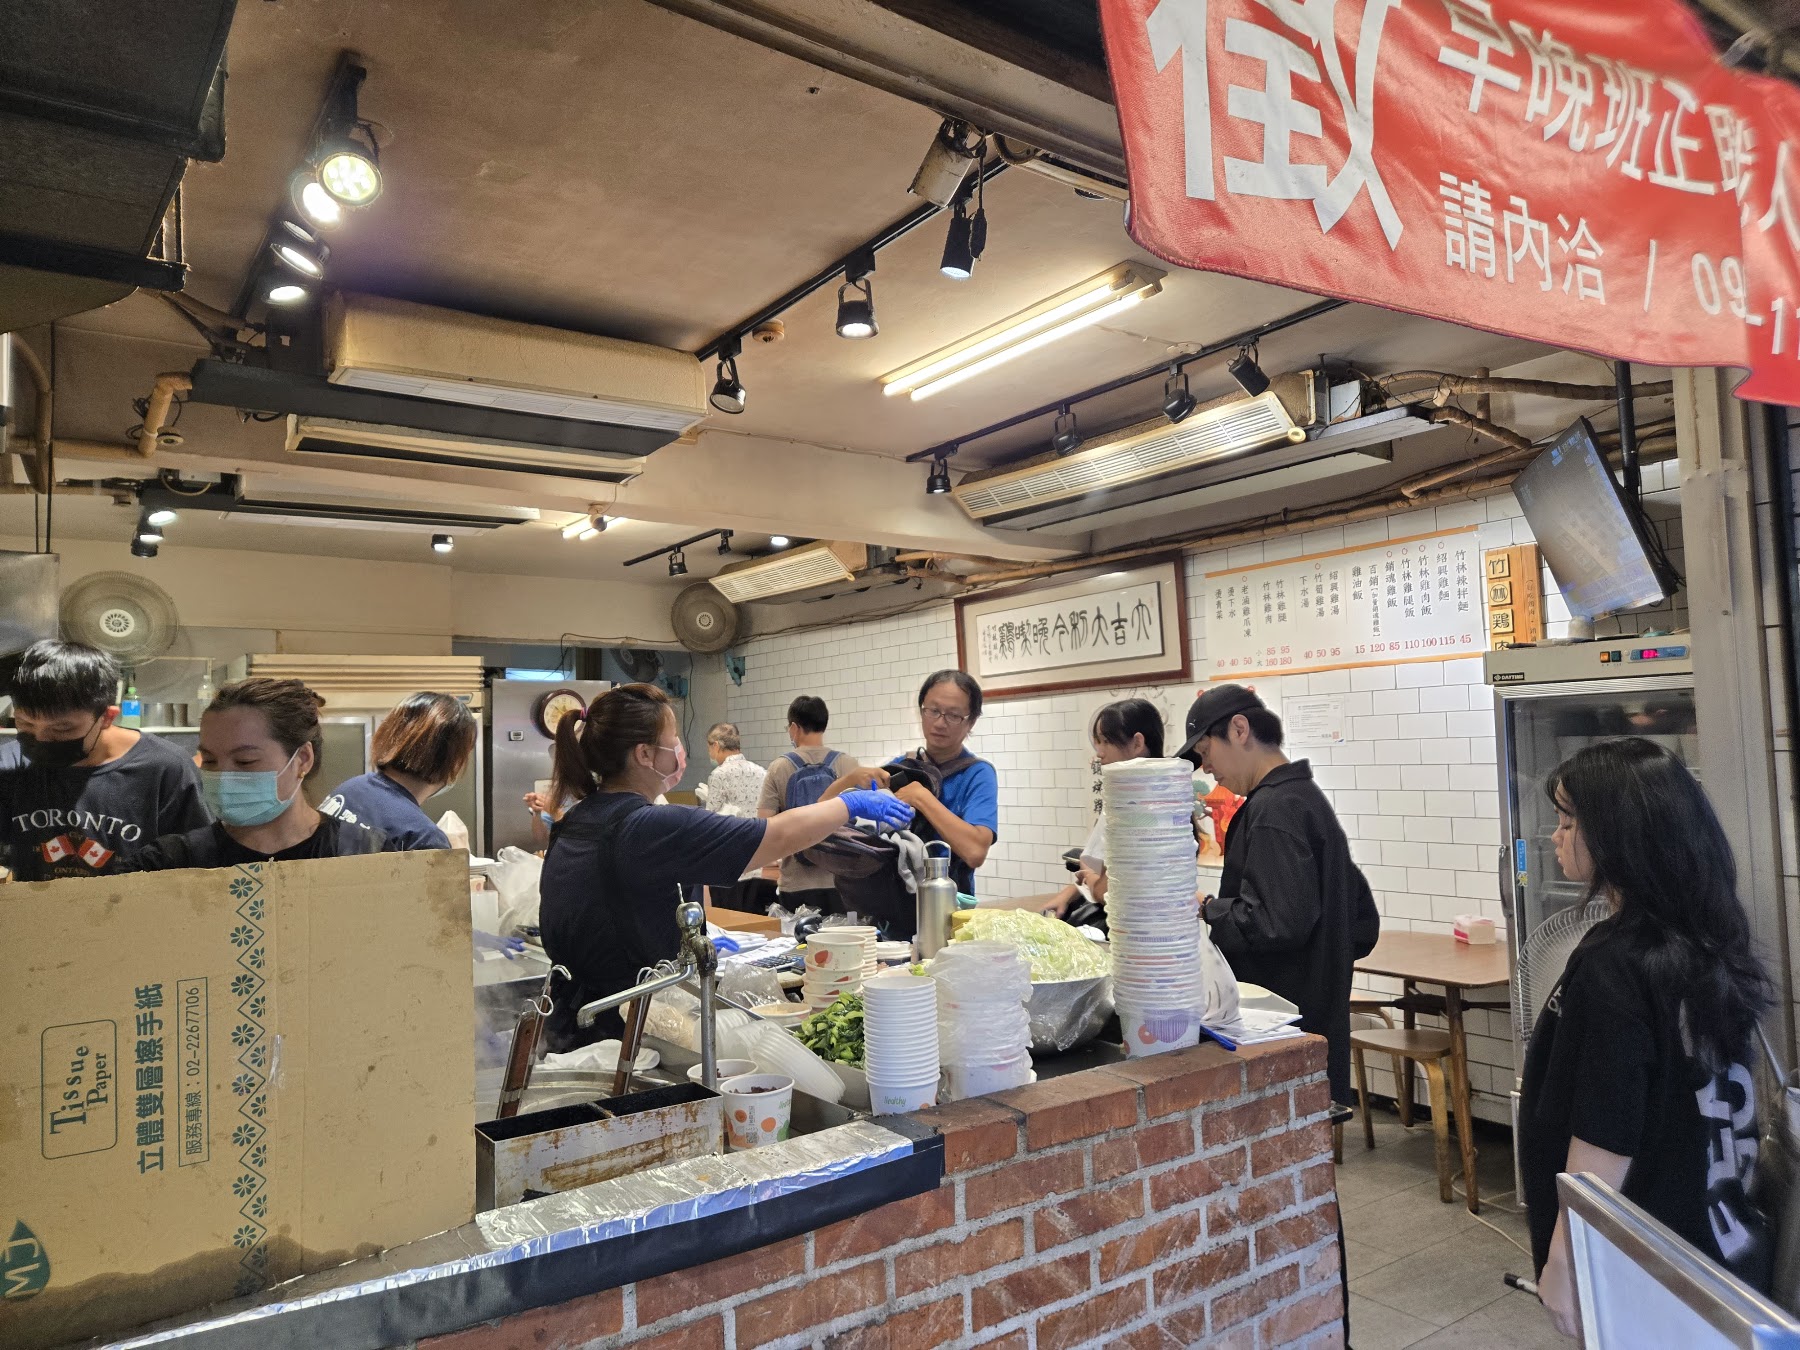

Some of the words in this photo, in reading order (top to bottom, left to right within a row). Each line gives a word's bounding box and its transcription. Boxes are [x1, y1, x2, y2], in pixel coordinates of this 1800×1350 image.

[1303, 651, 1313, 659] 40
[1316, 649, 1326, 657] 50
[1330, 647, 1341, 656] 95
[1355, 645, 1366, 654] 15
[1369, 643, 1386, 653] 120
[1389, 641, 1400, 651] 85
[1404, 640, 1420, 650] 110
[1421, 637, 1437, 648] 100
[1439, 636, 1456, 646] 115
[1459, 634, 1472, 644] 45
[12, 808, 142, 842] TORONTO
[49, 1044, 90, 1136] Tissue
[86, 1052, 109, 1106] Paper
[134, 983, 165, 1175] 立體雙層擦手紙
